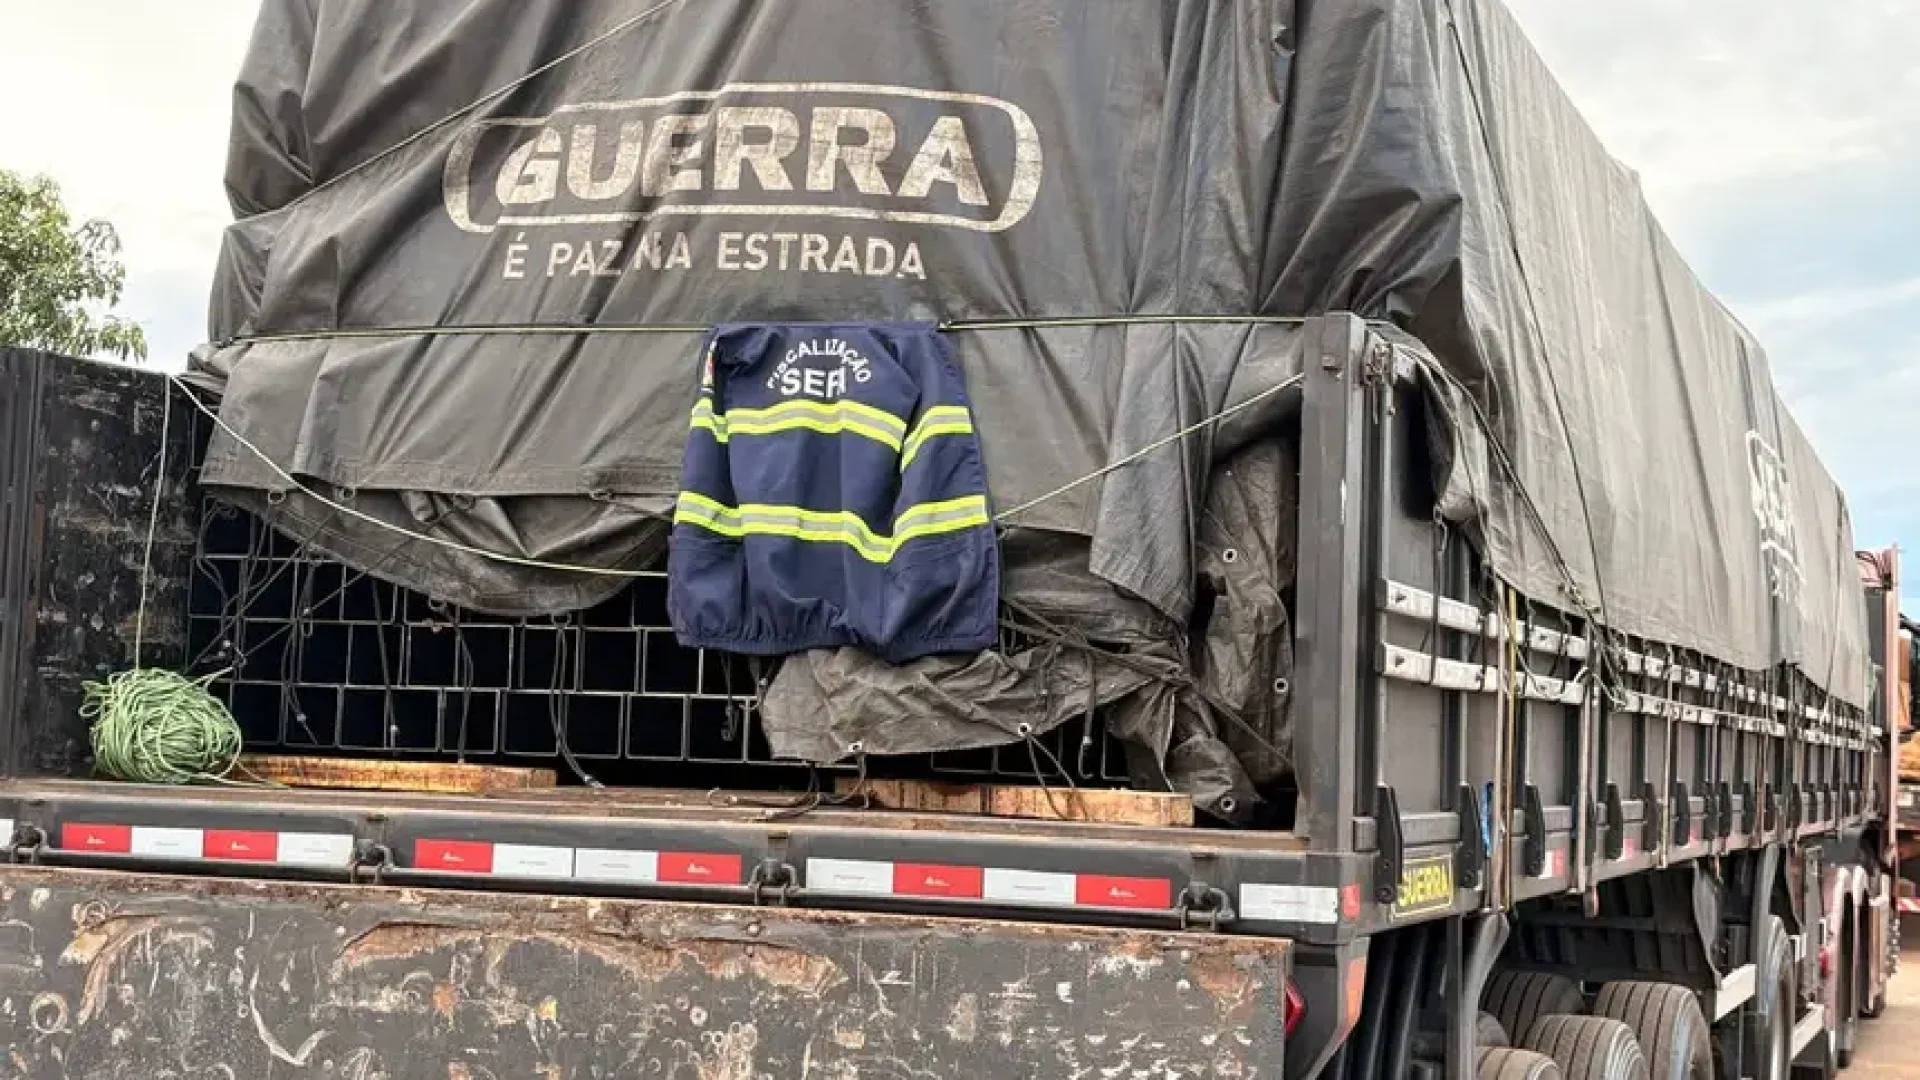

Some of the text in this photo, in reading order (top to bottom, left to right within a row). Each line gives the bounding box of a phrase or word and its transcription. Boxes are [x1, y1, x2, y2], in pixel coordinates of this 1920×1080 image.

[495, 105, 989, 206] GUERRA
[503, 233, 926, 280] É PAZ NA ESTRADA
